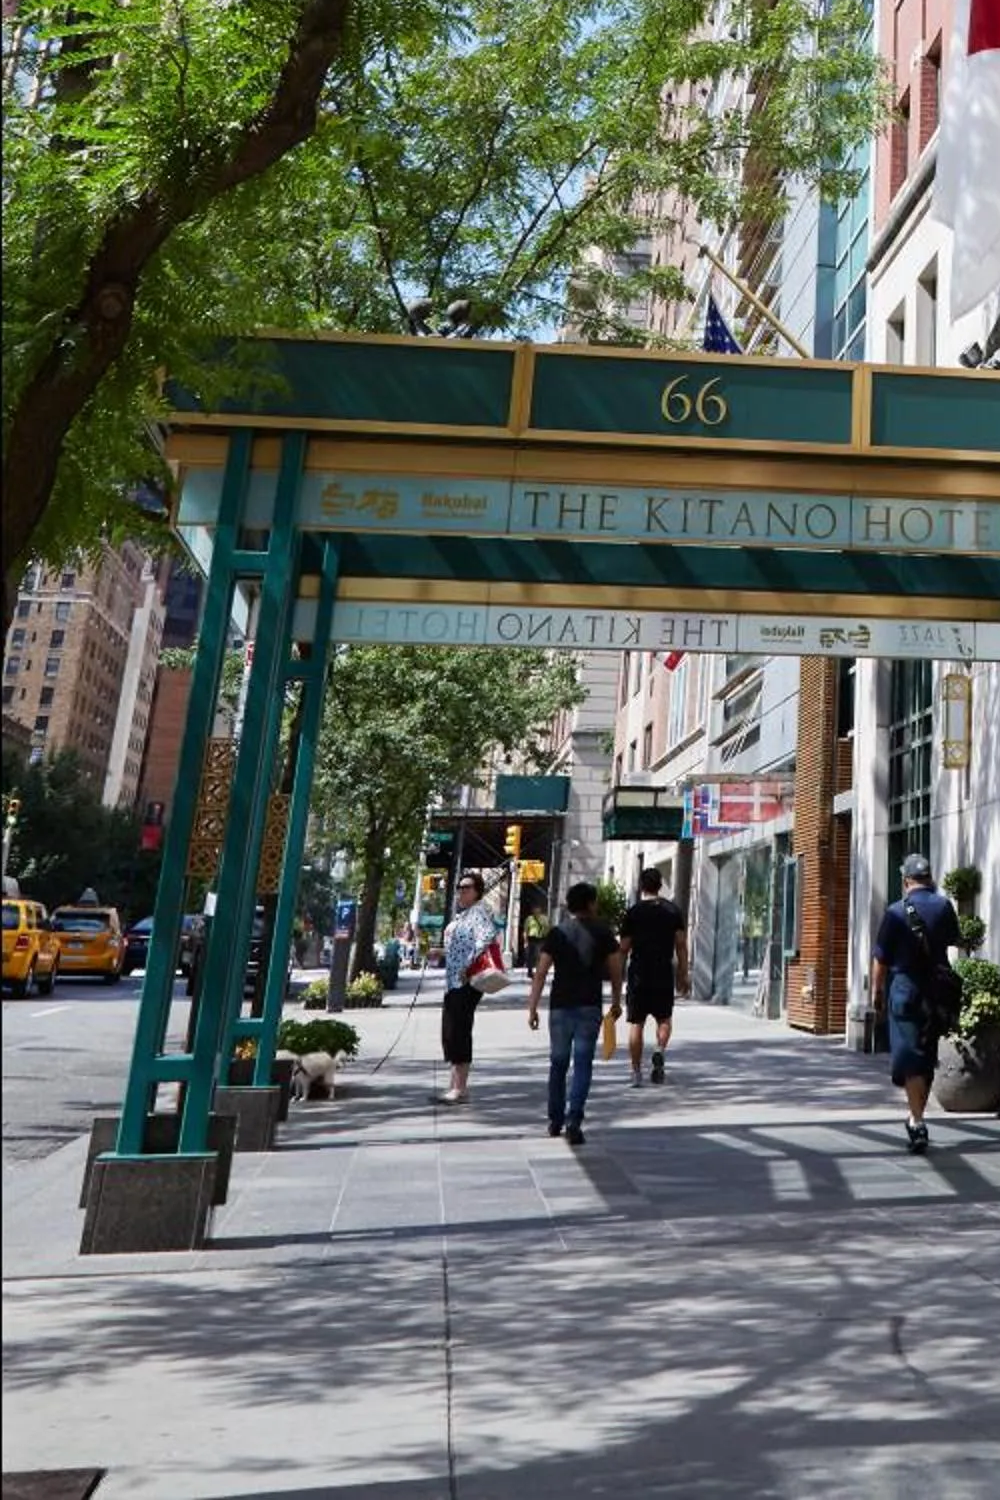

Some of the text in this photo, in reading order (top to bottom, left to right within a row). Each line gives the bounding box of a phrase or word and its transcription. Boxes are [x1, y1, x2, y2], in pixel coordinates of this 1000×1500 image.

[660, 373, 728, 426] 66
[420, 491, 488, 511] Hakubai
[524, 490, 620, 532] THE
[645, 497, 838, 540] KITANO
